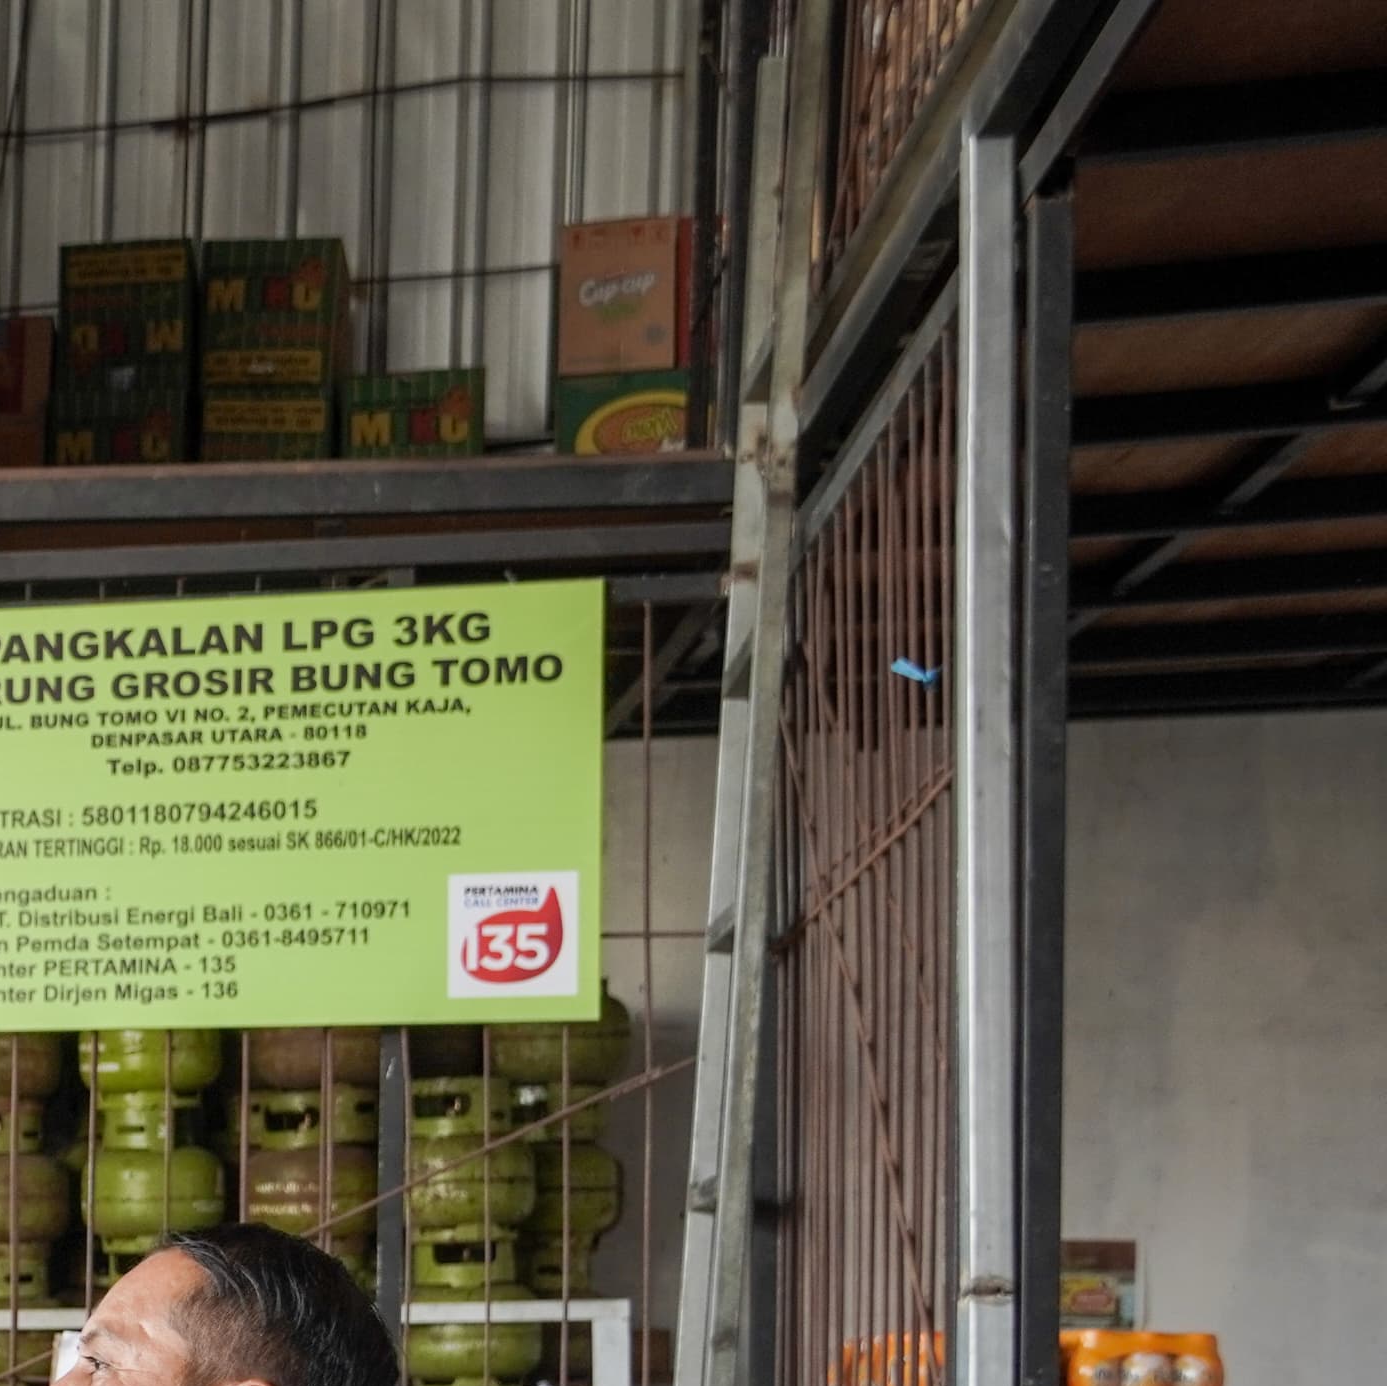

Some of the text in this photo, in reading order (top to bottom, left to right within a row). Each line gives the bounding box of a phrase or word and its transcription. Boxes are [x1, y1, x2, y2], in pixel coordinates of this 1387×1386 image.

[282, 617, 376, 652] LPG
[392, 611, 492, 647] 3KG
[111, 667, 275, 700] GROSIR
[290, 660, 416, 694] BUNG
[431, 653, 564, 687] TOMO
[30, 711, 90, 729] BUNG
[98, 709, 159, 727] TOMO
[166, 708, 187, 724] VI
[194, 706, 230, 723] NO.
[237, 706, 256, 723] 2,
[263, 700, 398, 721] PEMECUTAN
[405, 697, 472, 715] KAJA,
[91, 730, 204, 749] DENPASAR
[211, 727, 284, 745] UTARA
[303, 724, 368, 742] 80118
[107, 750, 352, 779] Telp. 087753223867
[80, 799, 318, 827] 5801180794246015
[34, 837, 125, 860] TERTINGGI
[138, 836, 167, 860] Rp.
[172, 834, 223, 854] 18.000
[227, 832, 281, 852] sesuai
[285, 830, 310, 850] SK
[463, 884, 539, 897] PERTAMINA
[17, 908, 120, 929] Distribusi
[126, 905, 196, 929] Energi
[202, 903, 243, 925] Bali
[263, 902, 313, 922] 0361
[335, 900, 411, 920] 710971
[16, 935, 90, 954] Pemda
[96, 933, 201, 954] Setempat
[221, 927, 371, 948] 0361-8495711
[466, 923, 549, 972] 135
[42, 957, 178, 978] PERTAMINA
[199, 955, 236, 974] 135
[42, 982, 108, 1006] Dirjen
[114, 980, 179, 1002] Migas
[200, 979, 238, 999] 136
